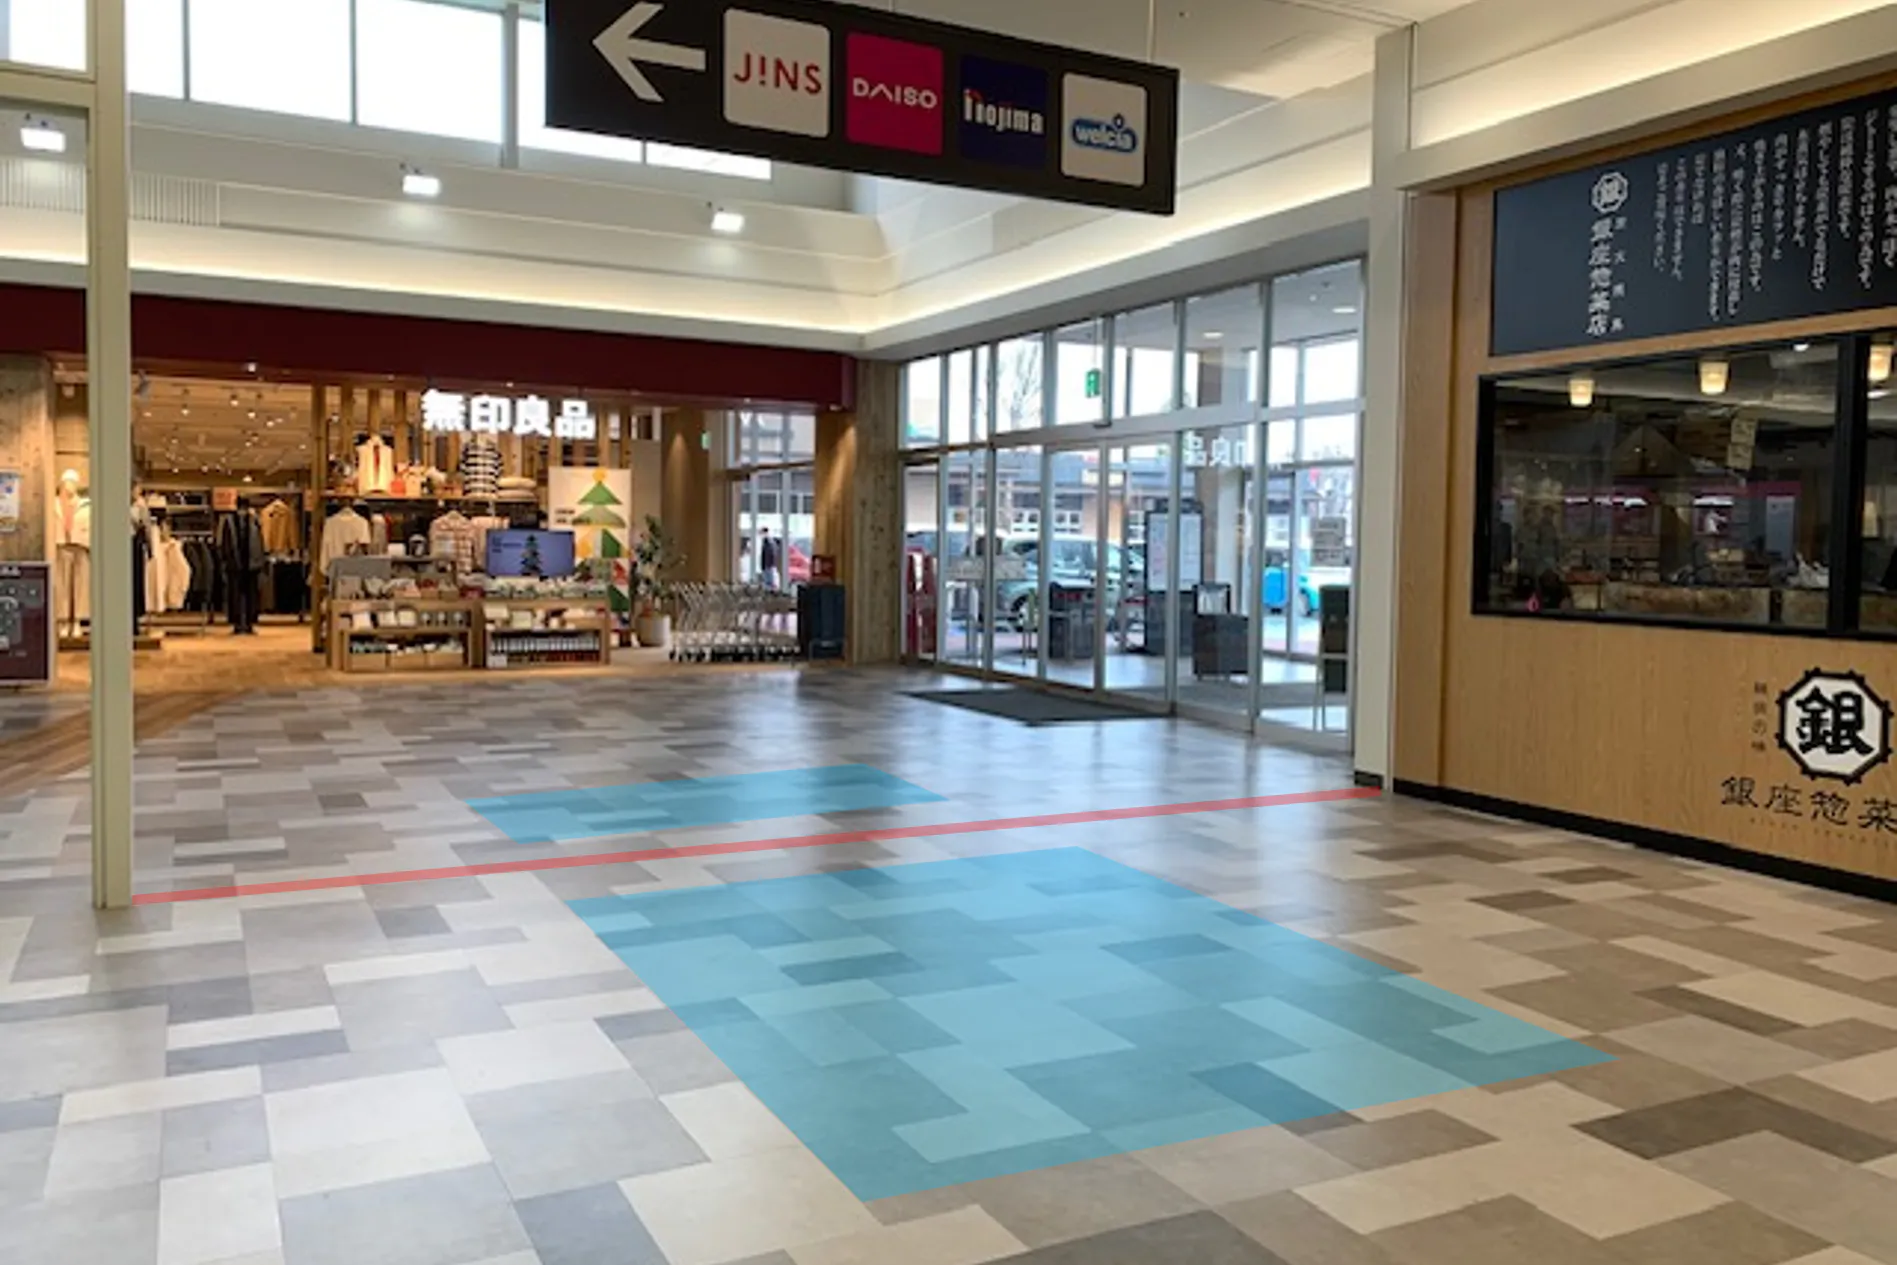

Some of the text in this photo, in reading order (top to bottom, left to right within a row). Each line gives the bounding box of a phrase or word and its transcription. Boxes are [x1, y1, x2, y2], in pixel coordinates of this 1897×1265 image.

[853, 77, 938, 110] DAISO
[421, 389, 596, 439] 無印良品
[1795, 686, 1874, 756] 銀
